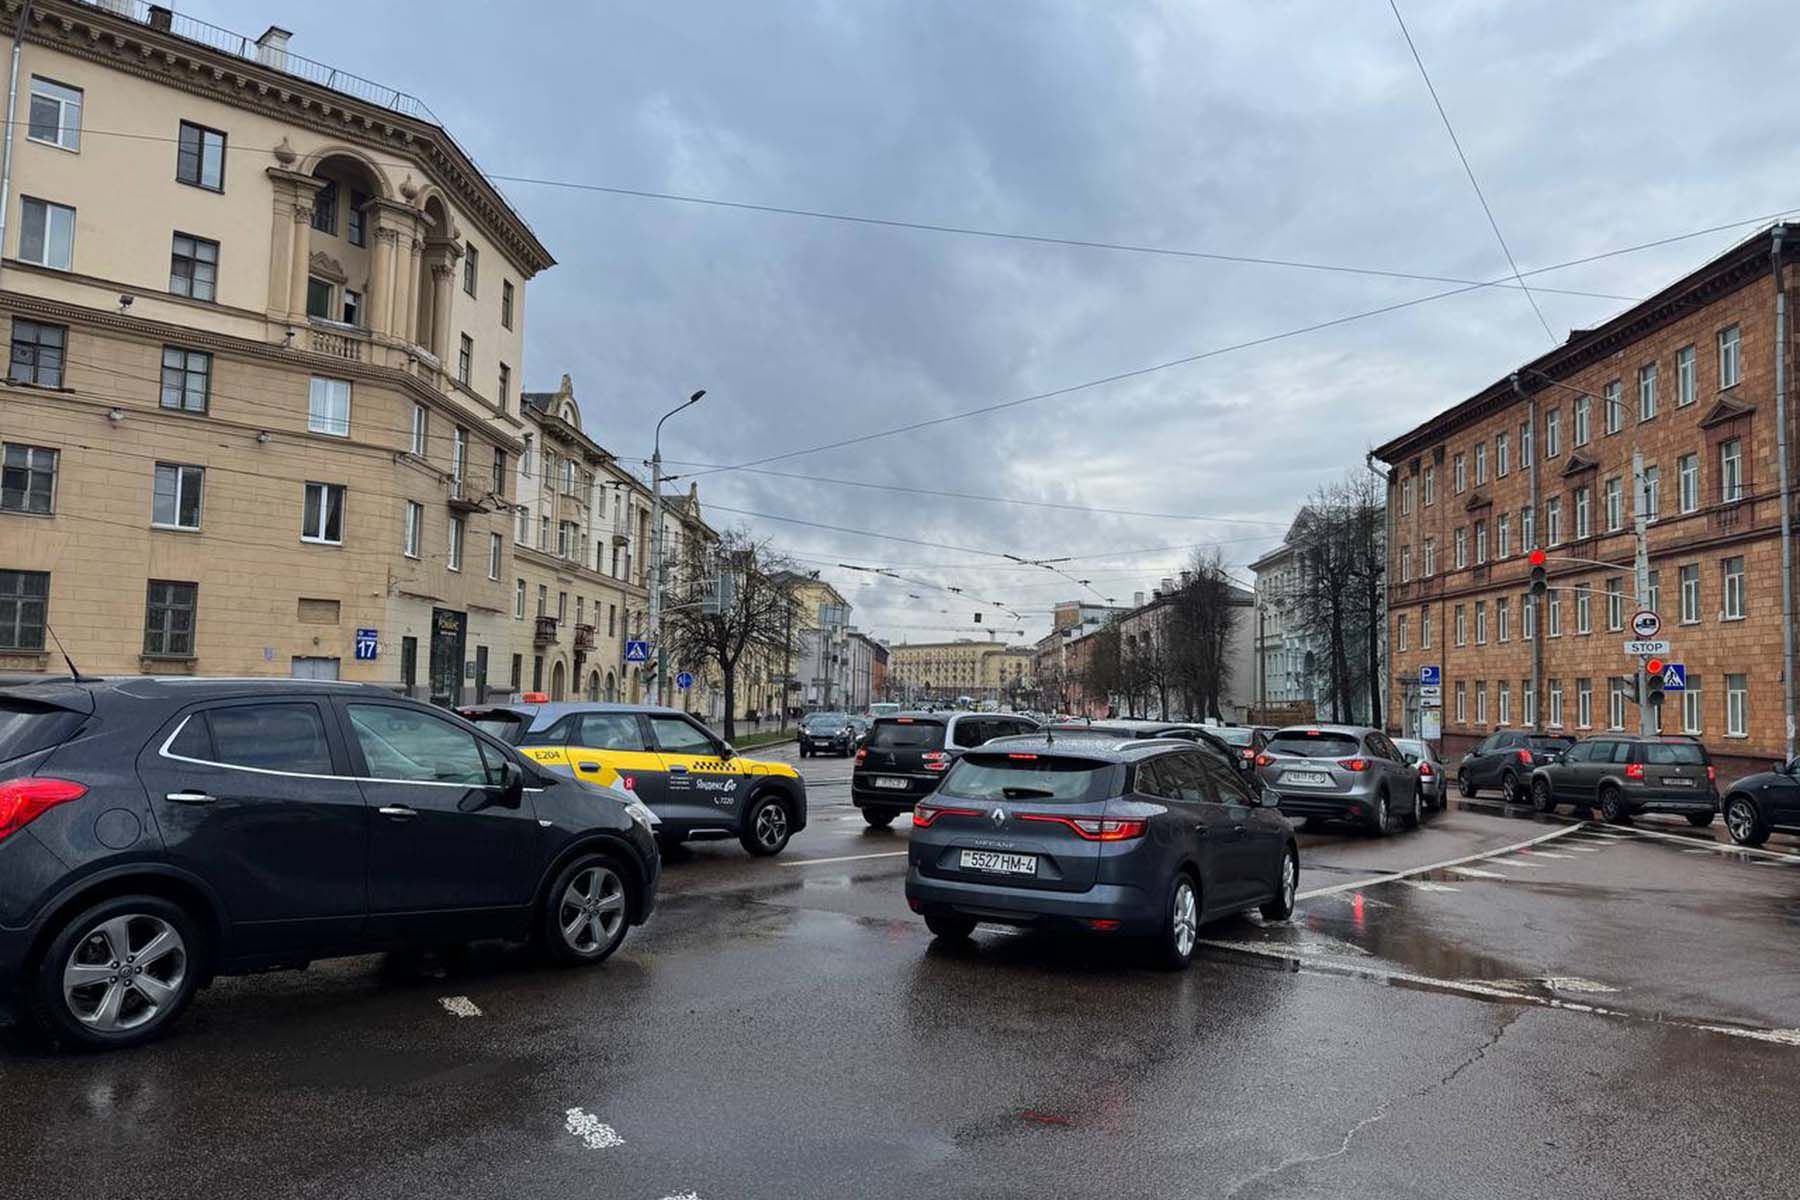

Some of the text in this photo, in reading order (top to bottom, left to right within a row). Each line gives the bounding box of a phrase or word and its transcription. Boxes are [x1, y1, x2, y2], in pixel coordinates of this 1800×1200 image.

[358, 641, 376, 658] 17
[1631, 643, 1663, 652] STOP
[534, 750, 561, 760] E204
[970, 852, 1000, 868] 5527
[1000, 855, 1034, 872] HM-4
